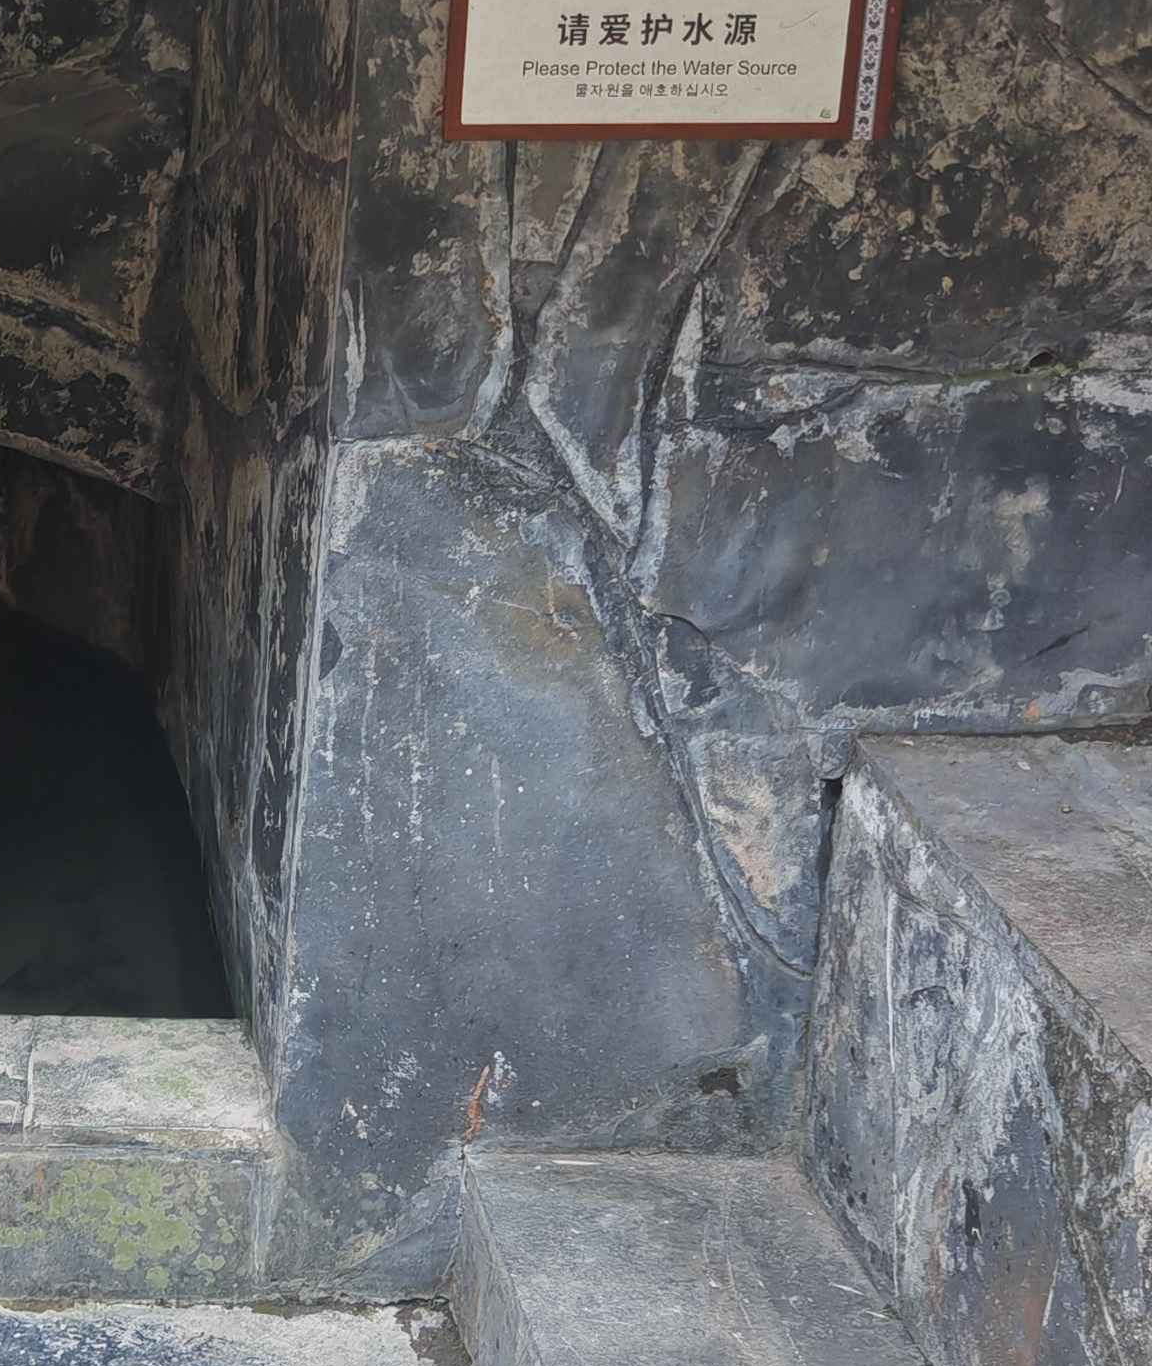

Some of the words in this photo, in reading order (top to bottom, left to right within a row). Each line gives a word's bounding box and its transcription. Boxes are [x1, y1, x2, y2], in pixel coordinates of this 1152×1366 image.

[557, 12, 758, 47] 请爱护水源
[521, 60, 580, 77] Please
[585, 60, 646, 77] Protect
[650, 60, 677, 77] the
[682, 60, 733, 77] Water
[737, 60, 798, 77] Source
